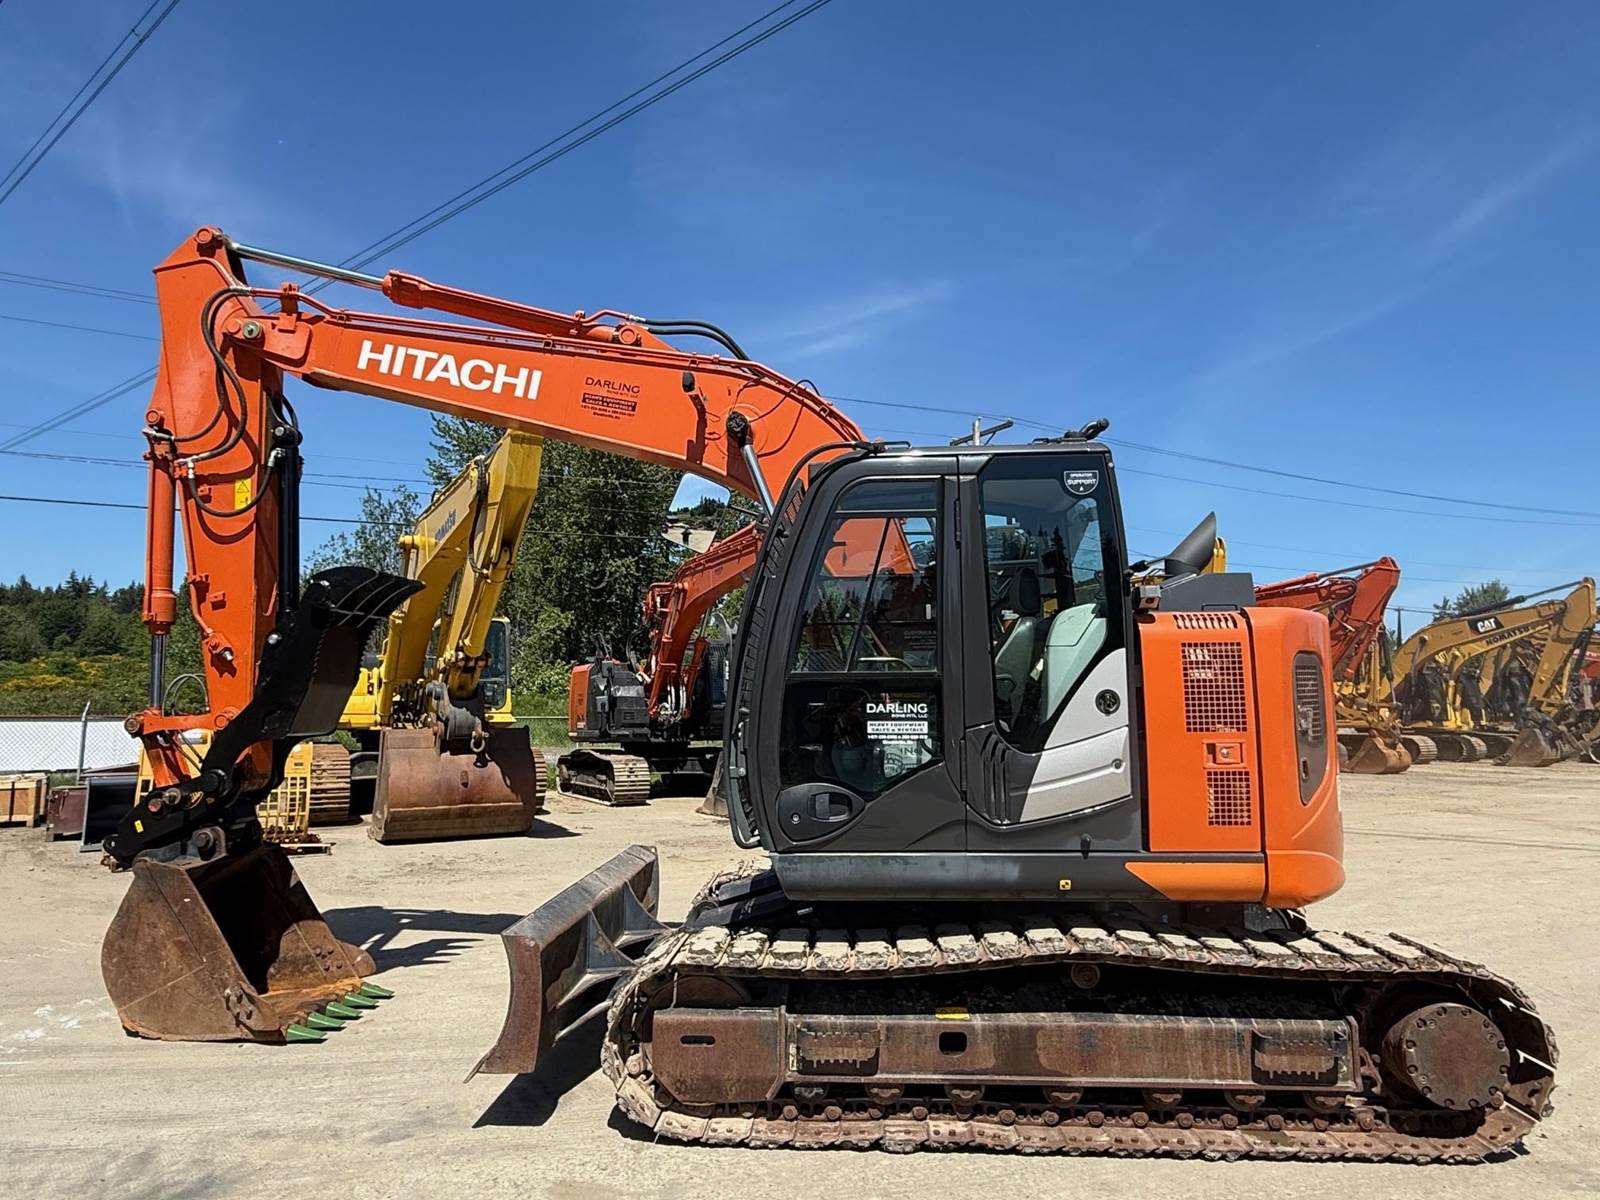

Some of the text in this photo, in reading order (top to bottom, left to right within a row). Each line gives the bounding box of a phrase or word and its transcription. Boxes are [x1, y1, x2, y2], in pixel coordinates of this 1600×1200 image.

[357, 340, 542, 400] HITACHI
[585, 377, 640, 394] DARLING
[1477, 618, 1496, 633] CAT
[1485, 626, 1530, 646] KOMATSU
[866, 703, 928, 713] DARLING
